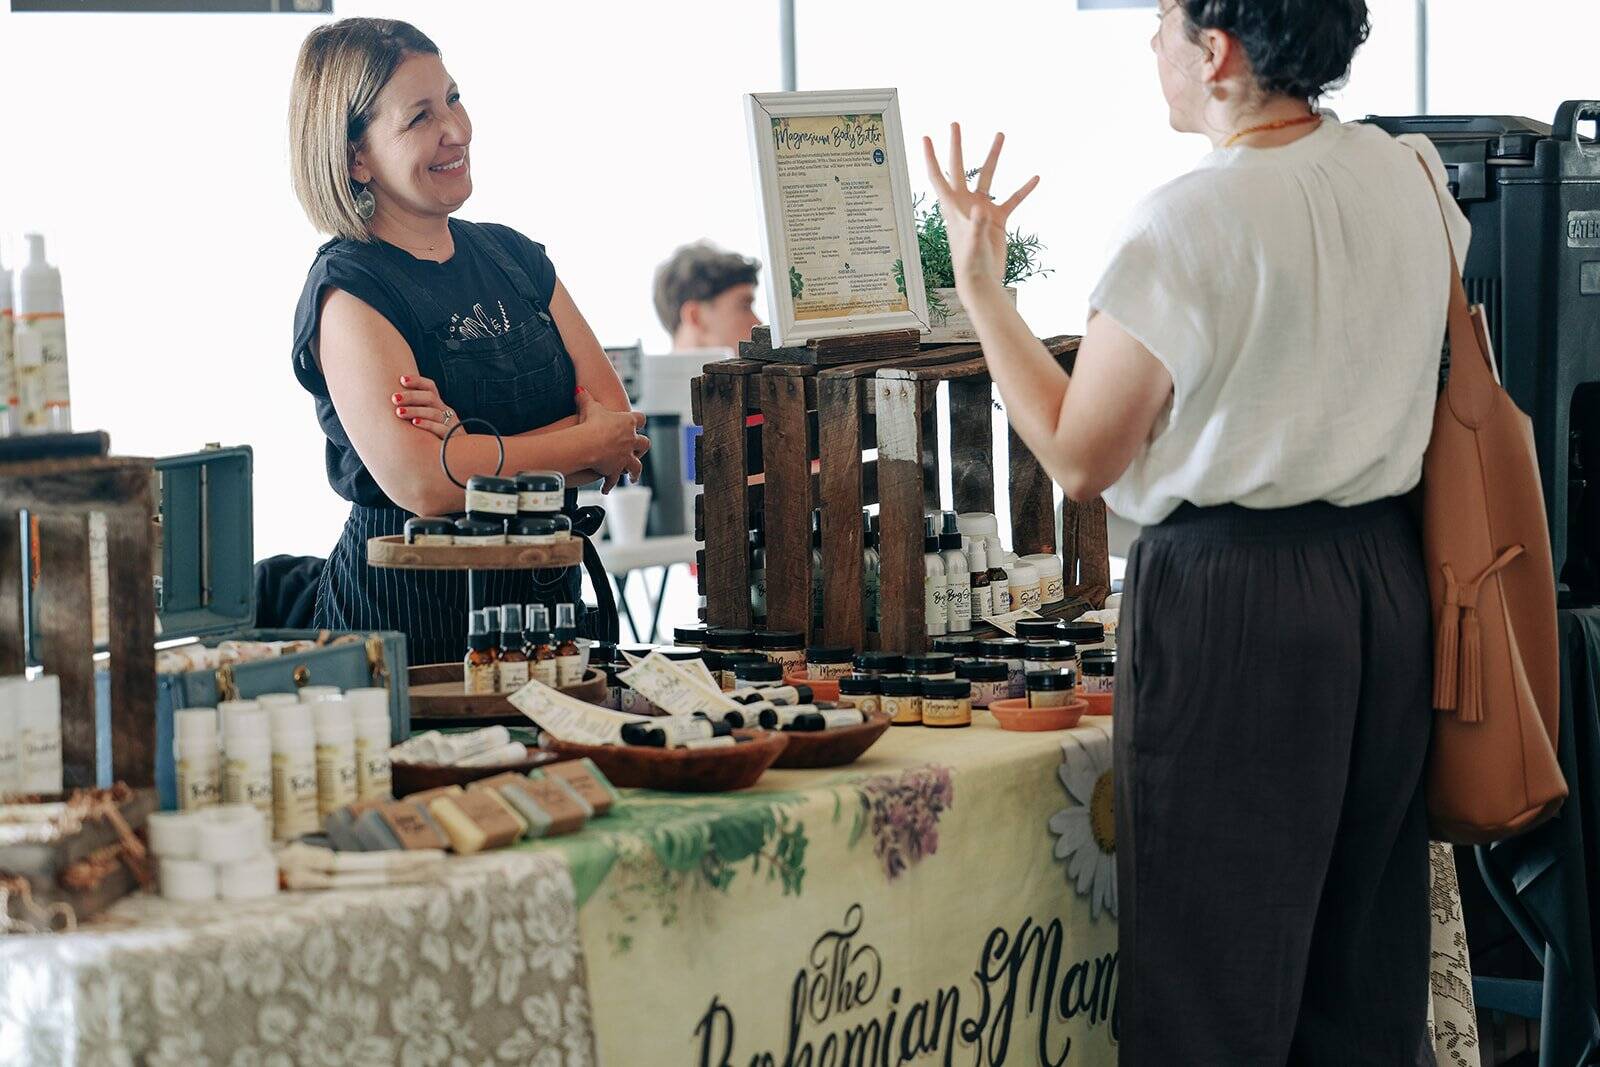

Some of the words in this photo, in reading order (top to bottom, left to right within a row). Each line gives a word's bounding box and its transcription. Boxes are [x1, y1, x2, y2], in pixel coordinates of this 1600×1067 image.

[774, 128, 830, 150] Magnesium
[831, 124, 856, 149] Body
[854, 124, 882, 146] Butter
[945, 588, 962, 603] Bug
[810, 903, 882, 1025] The
